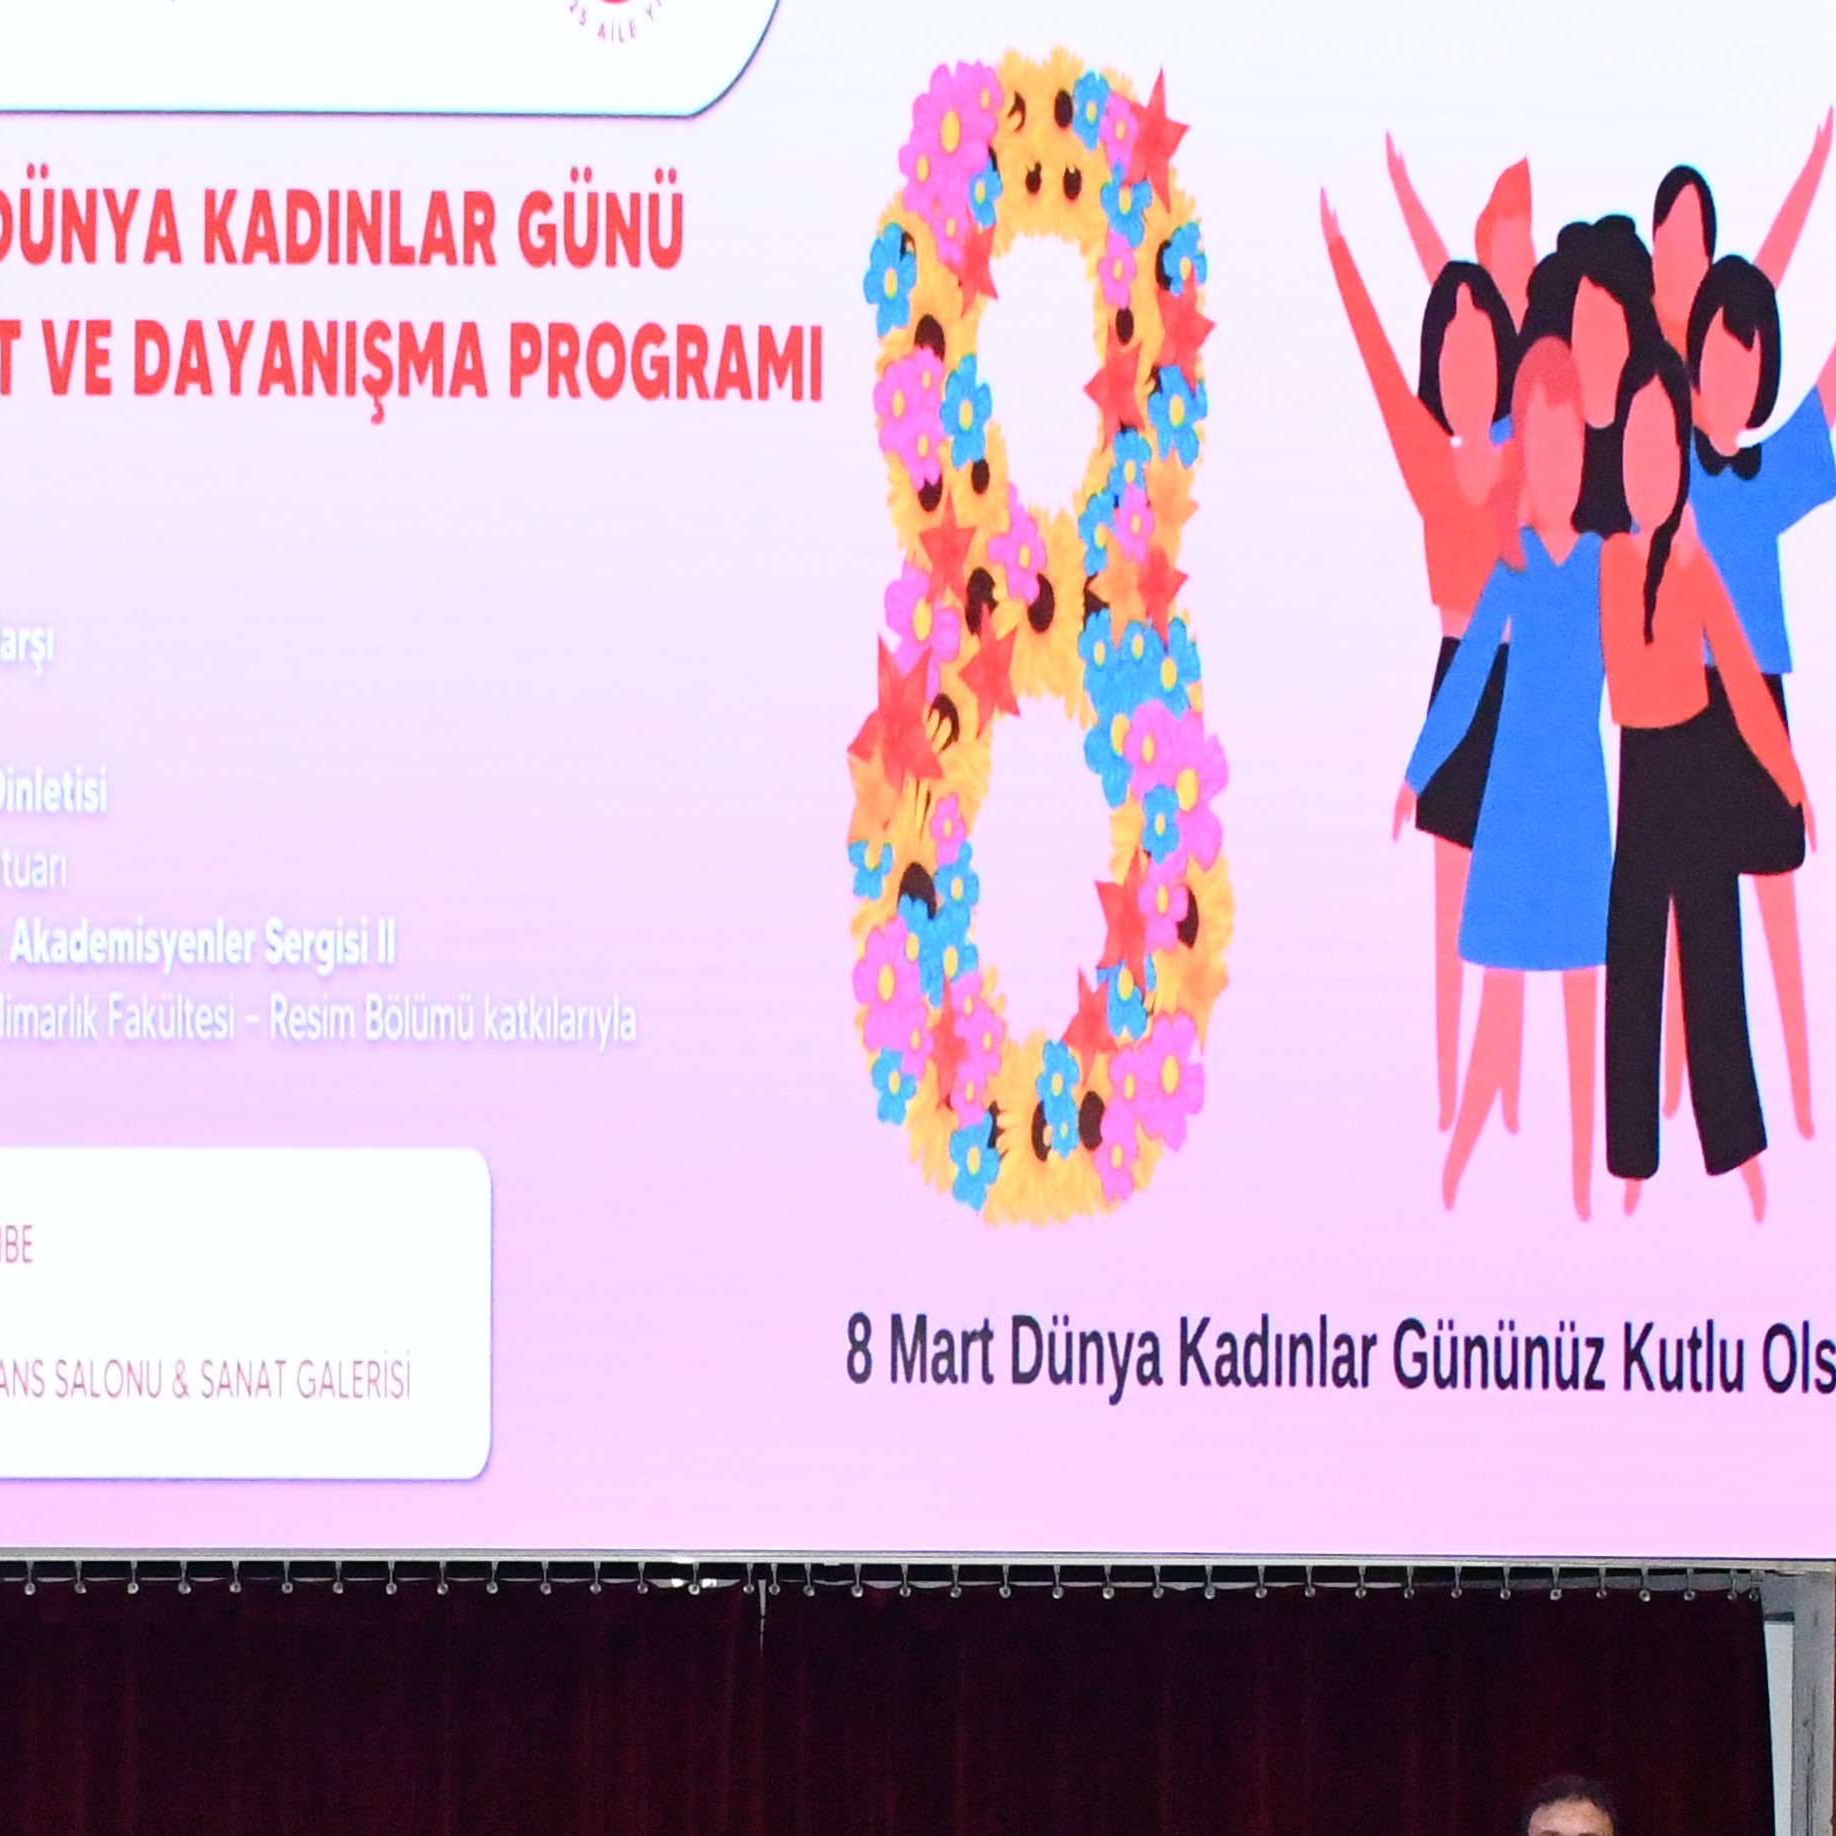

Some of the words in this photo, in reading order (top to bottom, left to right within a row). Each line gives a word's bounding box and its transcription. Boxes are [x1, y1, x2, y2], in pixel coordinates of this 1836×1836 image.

[204, 189, 497, 267] KADINLAR
[518, 167, 683, 270] GÜNÜ
[42, 319, 112, 396] VE
[134, 320, 488, 425] DAYANIŞMA
[510, 321, 822, 402] PROGRAMI
[10, 916, 256, 974] Akademisyenler
[265, 916, 368, 975] Sergisi
[378, 917, 394, 962] II
[109, 992, 234, 1039] Fakültesi
[271, 992, 355, 1039] Resim
[366, 993, 473, 1040] Bölümü
[485, 994, 636, 1051] katkılarıyla
[56, 1359, 161, 1398] SALONU
[174, 1360, 189, 1398] &
[202, 1360, 286, 1398] SANAT
[298, 1350, 409, 1398] GALERİSİ
[847, 1312, 872, 1383] 8
[891, 1314, 994, 1384] Mart
[1012, 1315, 1163, 1405] Dünya
[1180, 1314, 1377, 1388] Kadınlar
[1394, 1318, 1605, 1391] Gününüz
[1624, 1319, 1744, 1393] Kutlu
